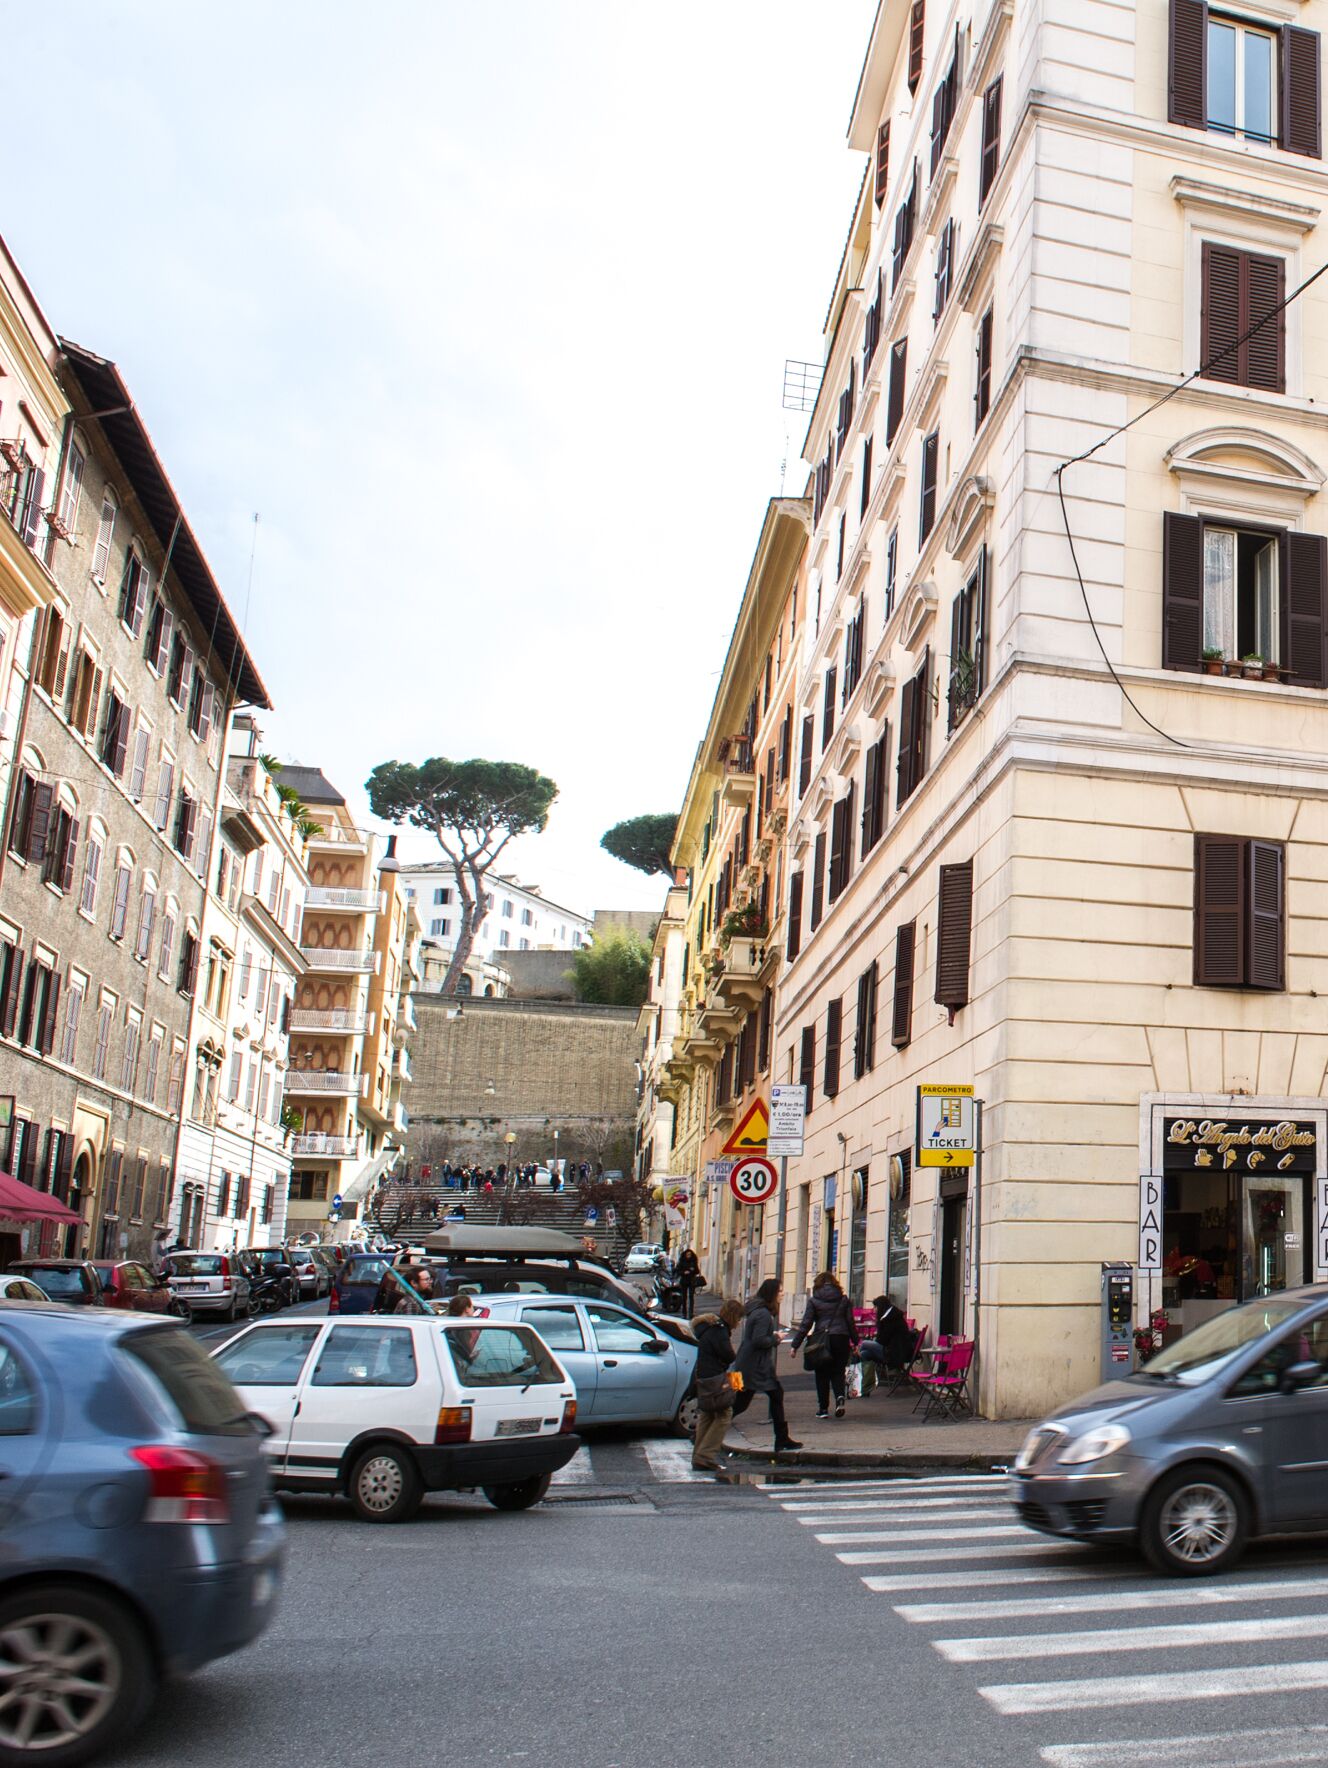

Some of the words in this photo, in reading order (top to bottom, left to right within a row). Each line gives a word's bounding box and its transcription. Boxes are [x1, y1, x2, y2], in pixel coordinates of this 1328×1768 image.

[928, 1139, 967, 1147] TICKET
[1251, 1126, 1275, 1146] del
[1272, 1121, 1317, 1150] Gusto
[740, 1170, 767, 1191] 30
[1141, 1182, 1160, 1262] BAR
